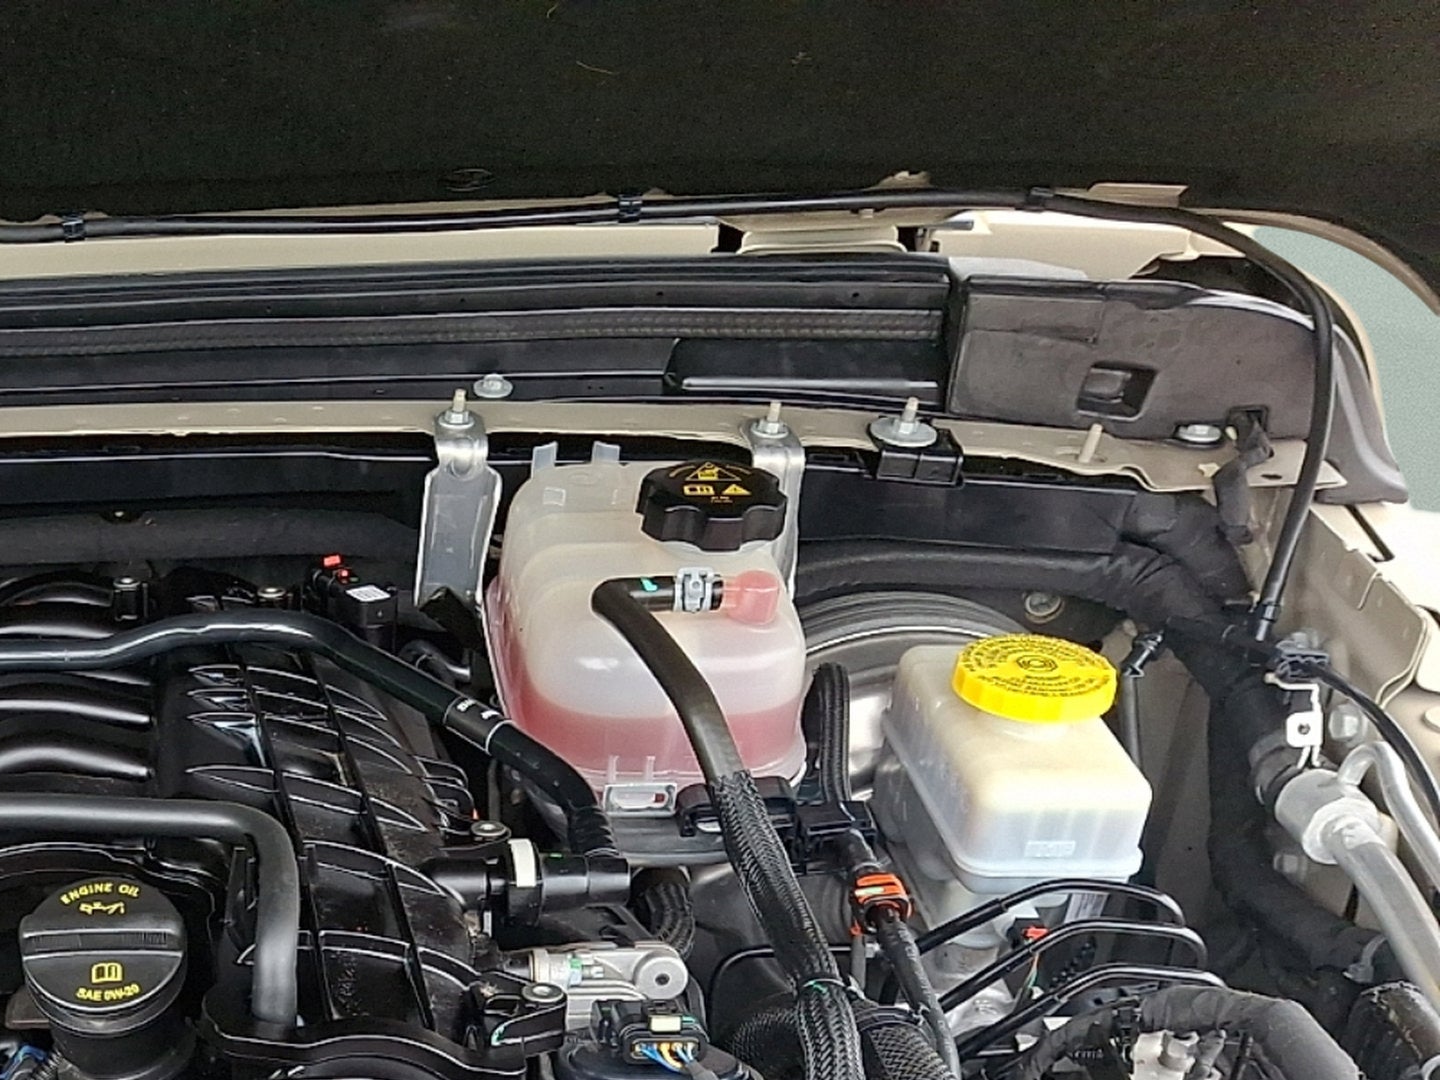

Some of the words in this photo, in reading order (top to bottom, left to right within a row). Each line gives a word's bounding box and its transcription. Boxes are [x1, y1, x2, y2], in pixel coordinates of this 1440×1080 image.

[60, 882, 113, 904] ENGINE
[118, 883, 140, 897] OIL
[75, 987, 102, 1001] SAE
